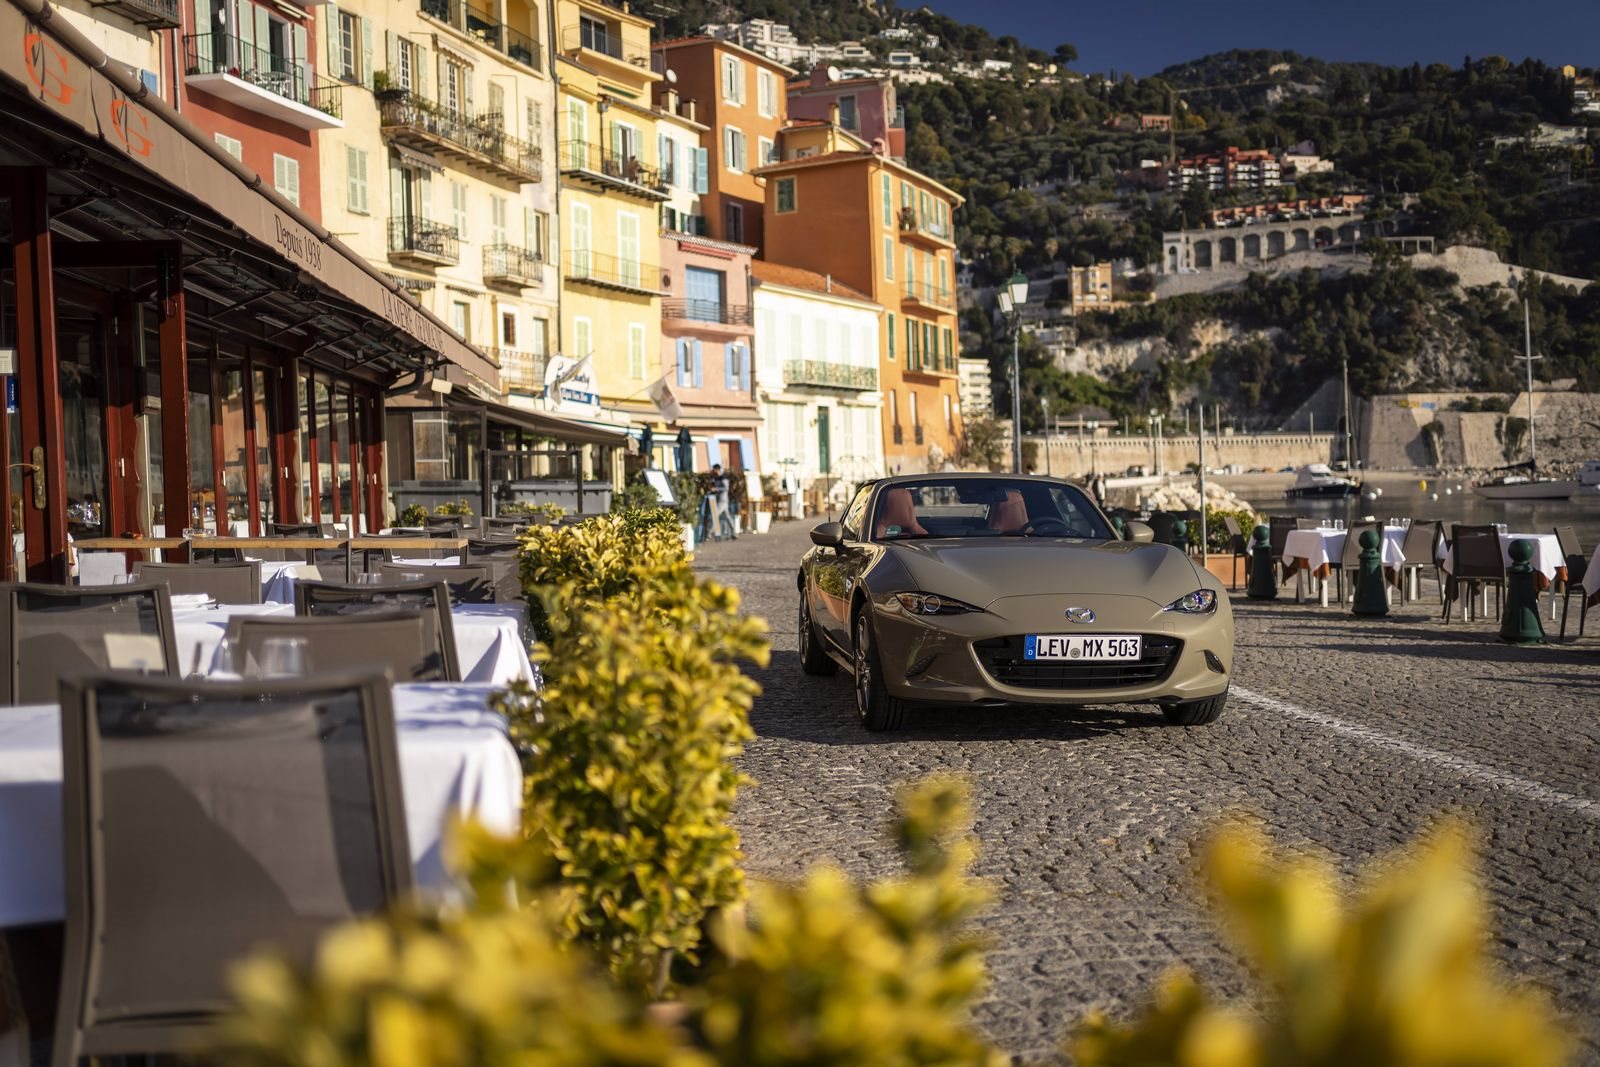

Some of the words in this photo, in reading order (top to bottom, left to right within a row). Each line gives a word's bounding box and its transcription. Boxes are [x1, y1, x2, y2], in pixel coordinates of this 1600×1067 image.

[275, 214, 303, 258] Depuis
[304, 236, 322, 271] 1938
[1037, 639, 1071, 657] LEV
[1082, 639, 1104, 657] MX
[1108, 639, 1138, 657] 503
